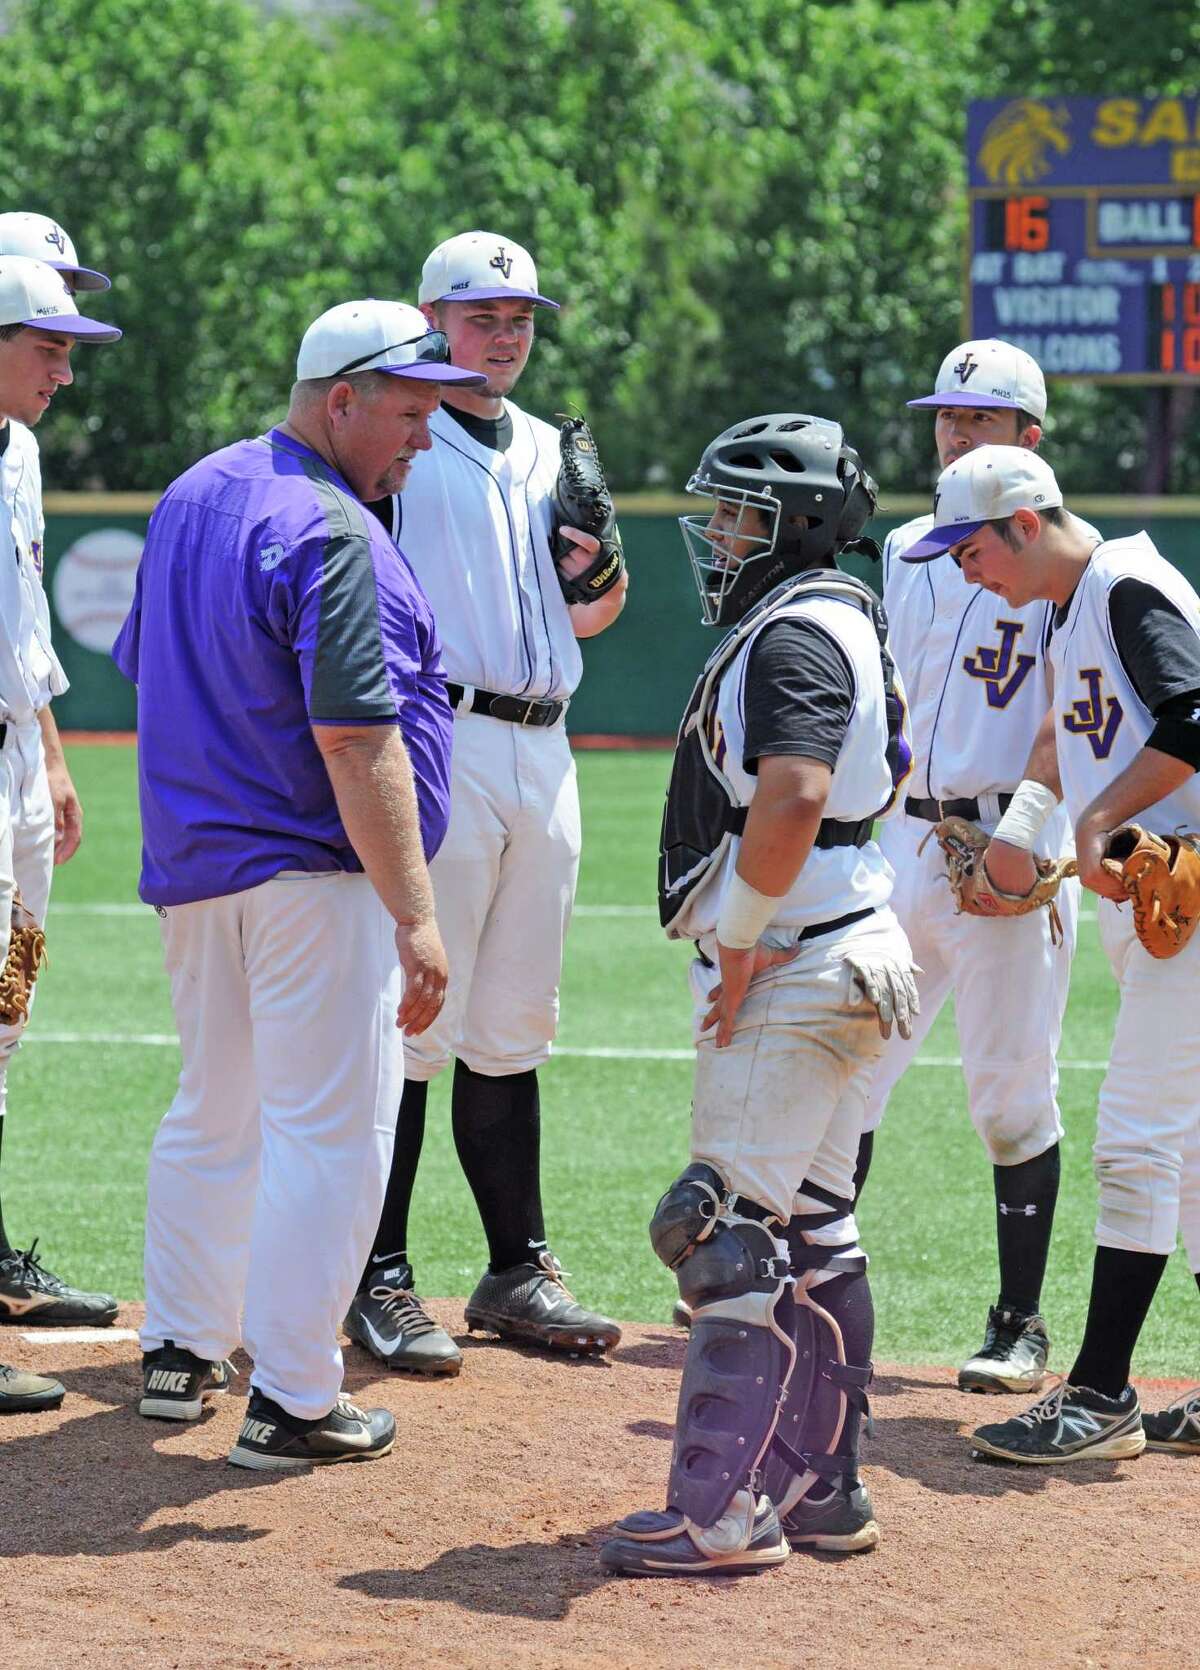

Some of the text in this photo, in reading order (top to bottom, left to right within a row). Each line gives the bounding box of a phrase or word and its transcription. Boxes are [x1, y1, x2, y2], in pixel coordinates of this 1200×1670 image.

[1092, 98, 1200, 146] SA
[1099, 202, 1191, 242] BALL
[993, 285, 1121, 325] VISITOR
[589, 552, 619, 588] Wilson
[963, 619, 1037, 710] JV
[1062, 667, 1124, 762] JV
[147, 1369, 191, 1393] NIKE
